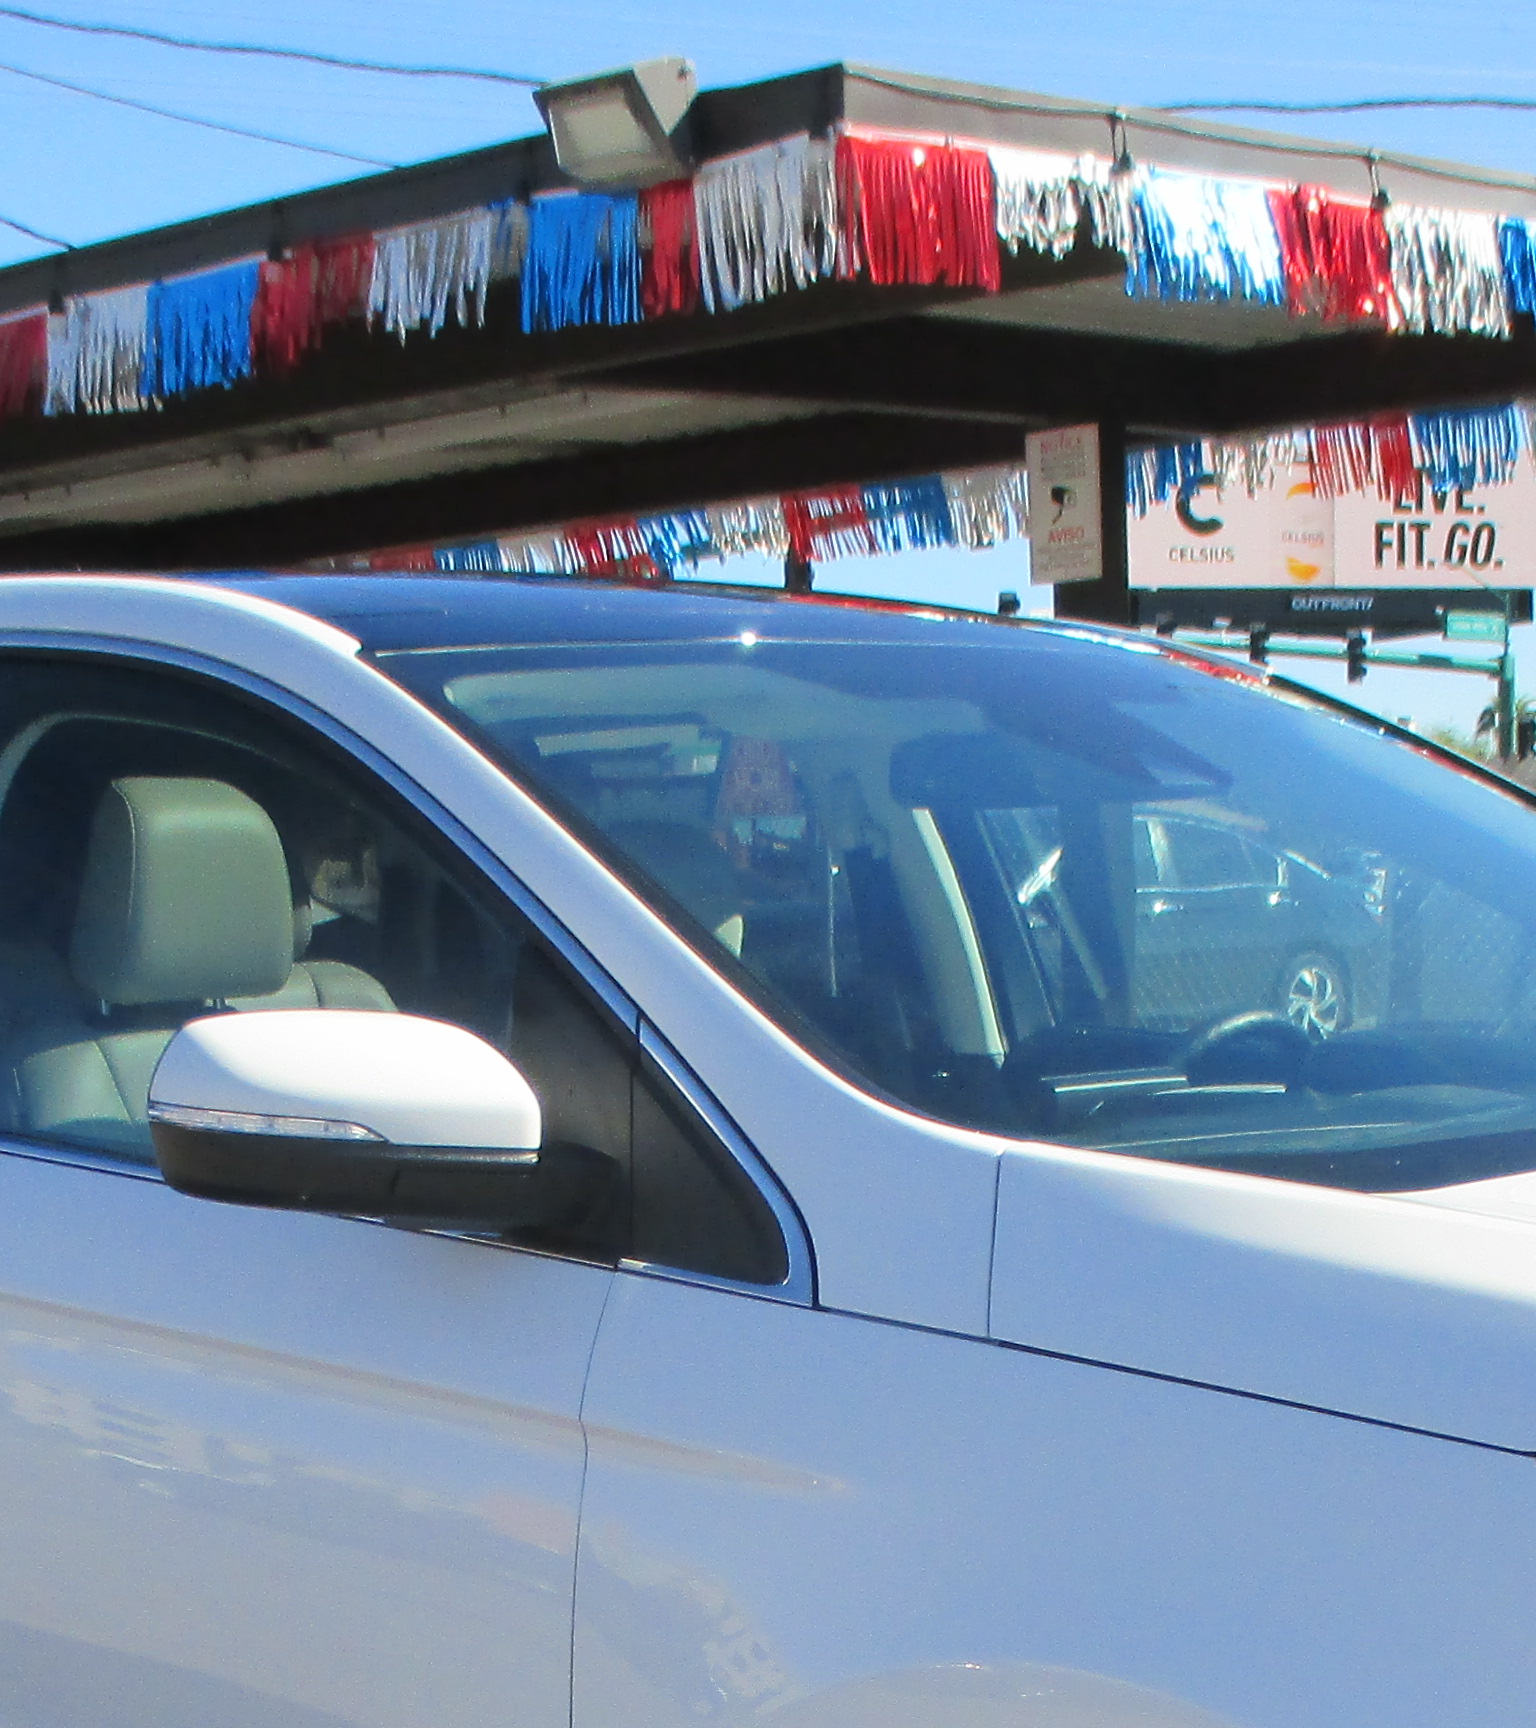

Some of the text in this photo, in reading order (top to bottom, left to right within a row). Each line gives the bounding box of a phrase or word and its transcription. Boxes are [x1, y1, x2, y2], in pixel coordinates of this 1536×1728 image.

[1168, 547, 1235, 564] CELSIUS
[1373, 520, 1505, 570] FIT. GO.
